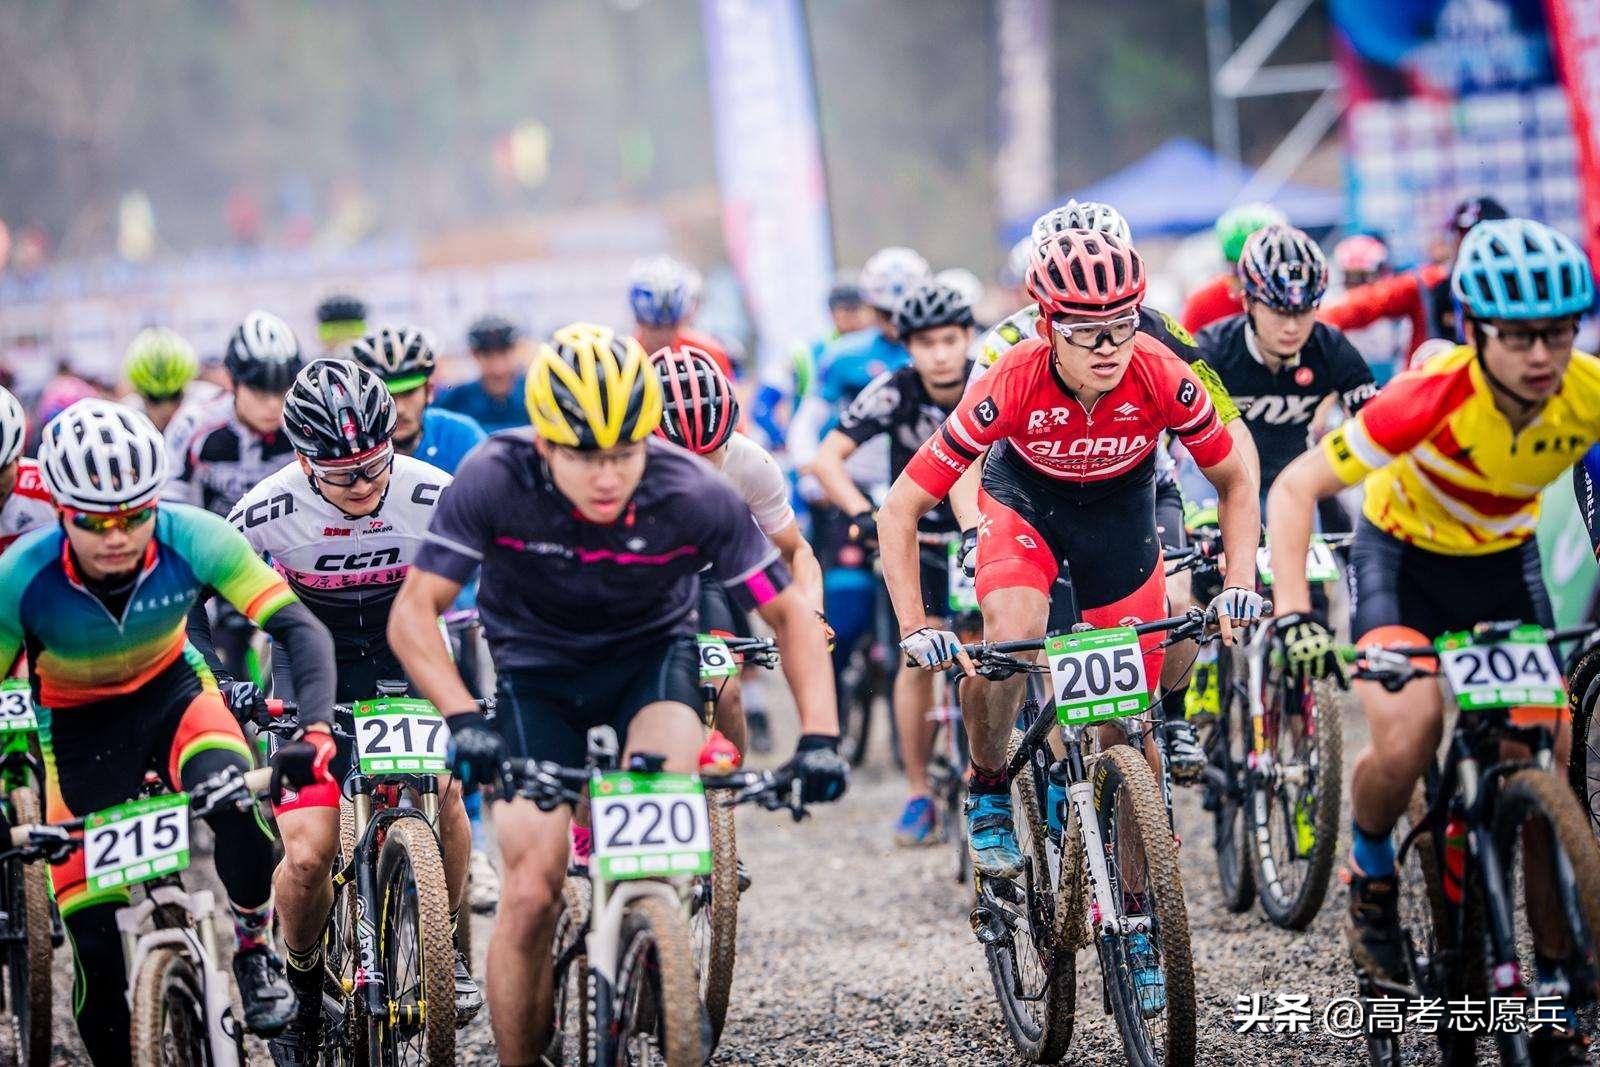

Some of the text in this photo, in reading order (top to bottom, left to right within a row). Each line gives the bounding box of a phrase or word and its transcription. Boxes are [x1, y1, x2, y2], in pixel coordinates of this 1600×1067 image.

[1026, 435, 1148, 458] GLORIA
[1058, 648, 1139, 700] 205
[1455, 648, 1548, 685] 204
[363, 718, 443, 754] 217
[93, 812, 179, 869] 215
[605, 801, 695, 848] 220
